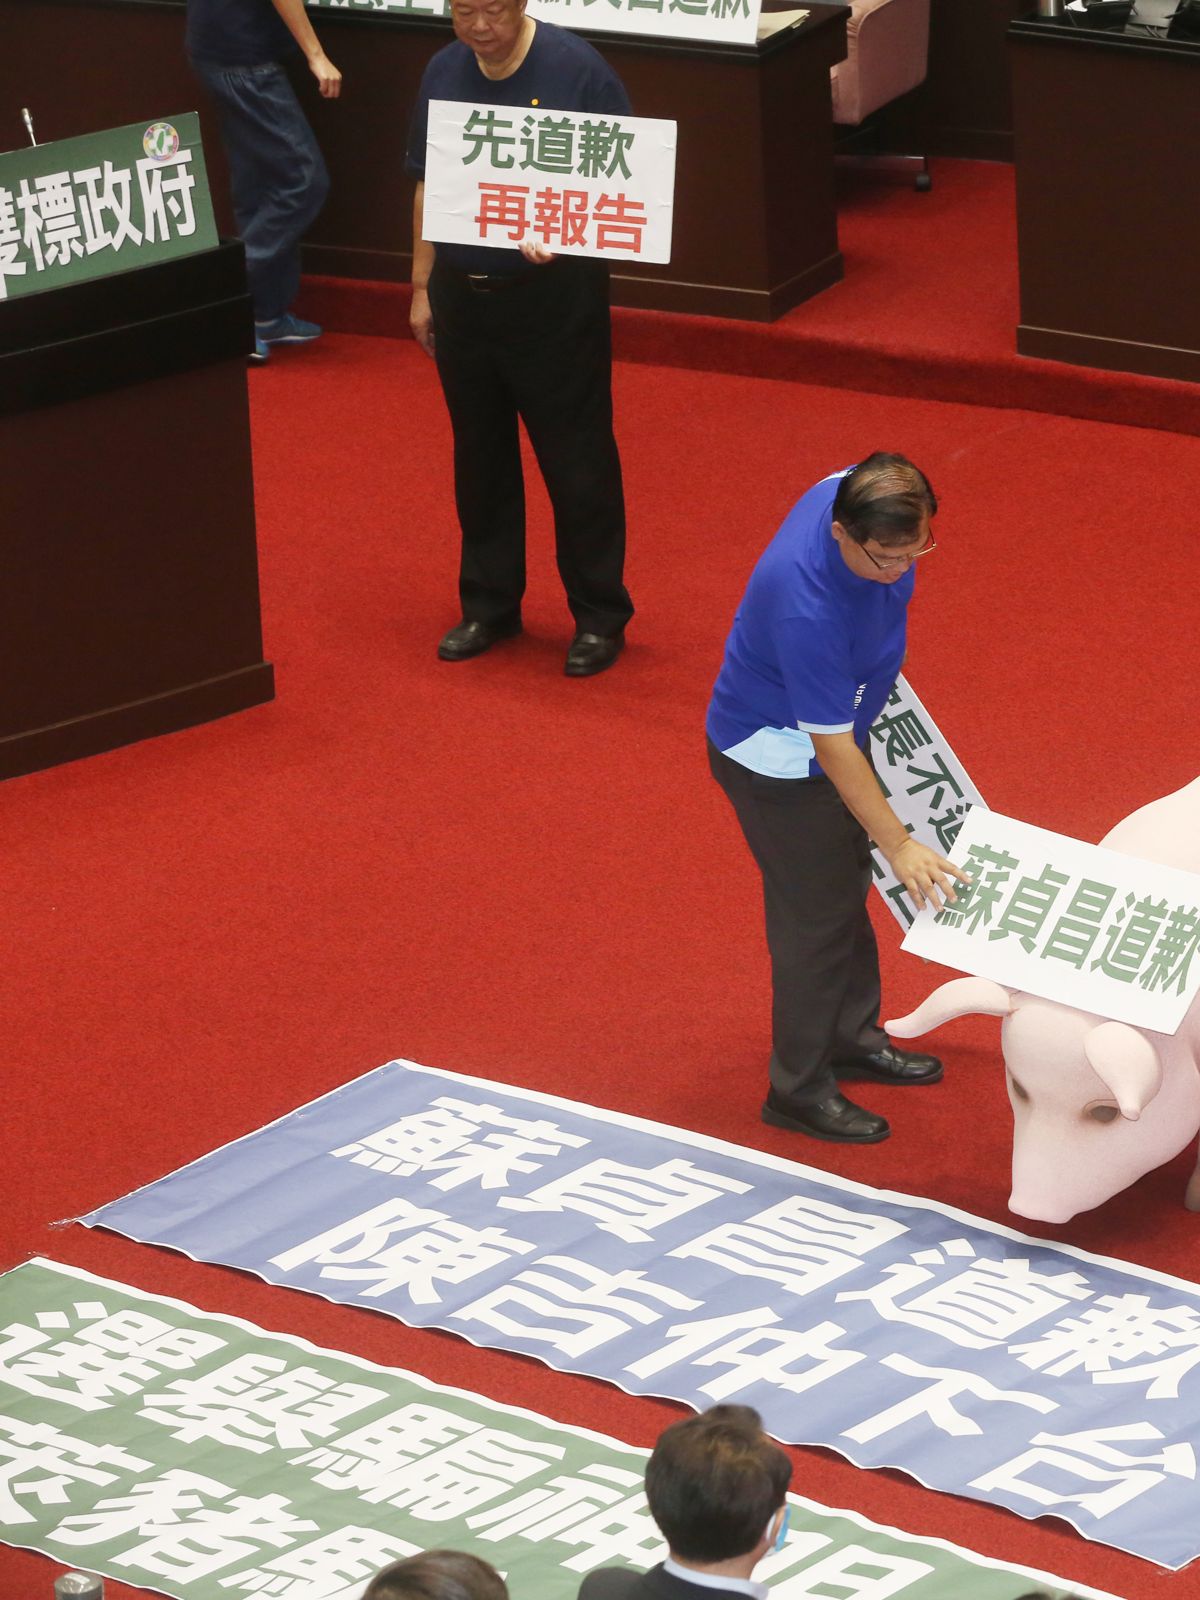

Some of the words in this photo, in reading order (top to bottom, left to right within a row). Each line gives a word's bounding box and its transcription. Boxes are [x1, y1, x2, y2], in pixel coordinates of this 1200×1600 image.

[462, 111, 635, 180] 先道歉
[475, 183, 647, 253] 再報告
[267, 1197, 1196, 1518] 陳吉仲下台
